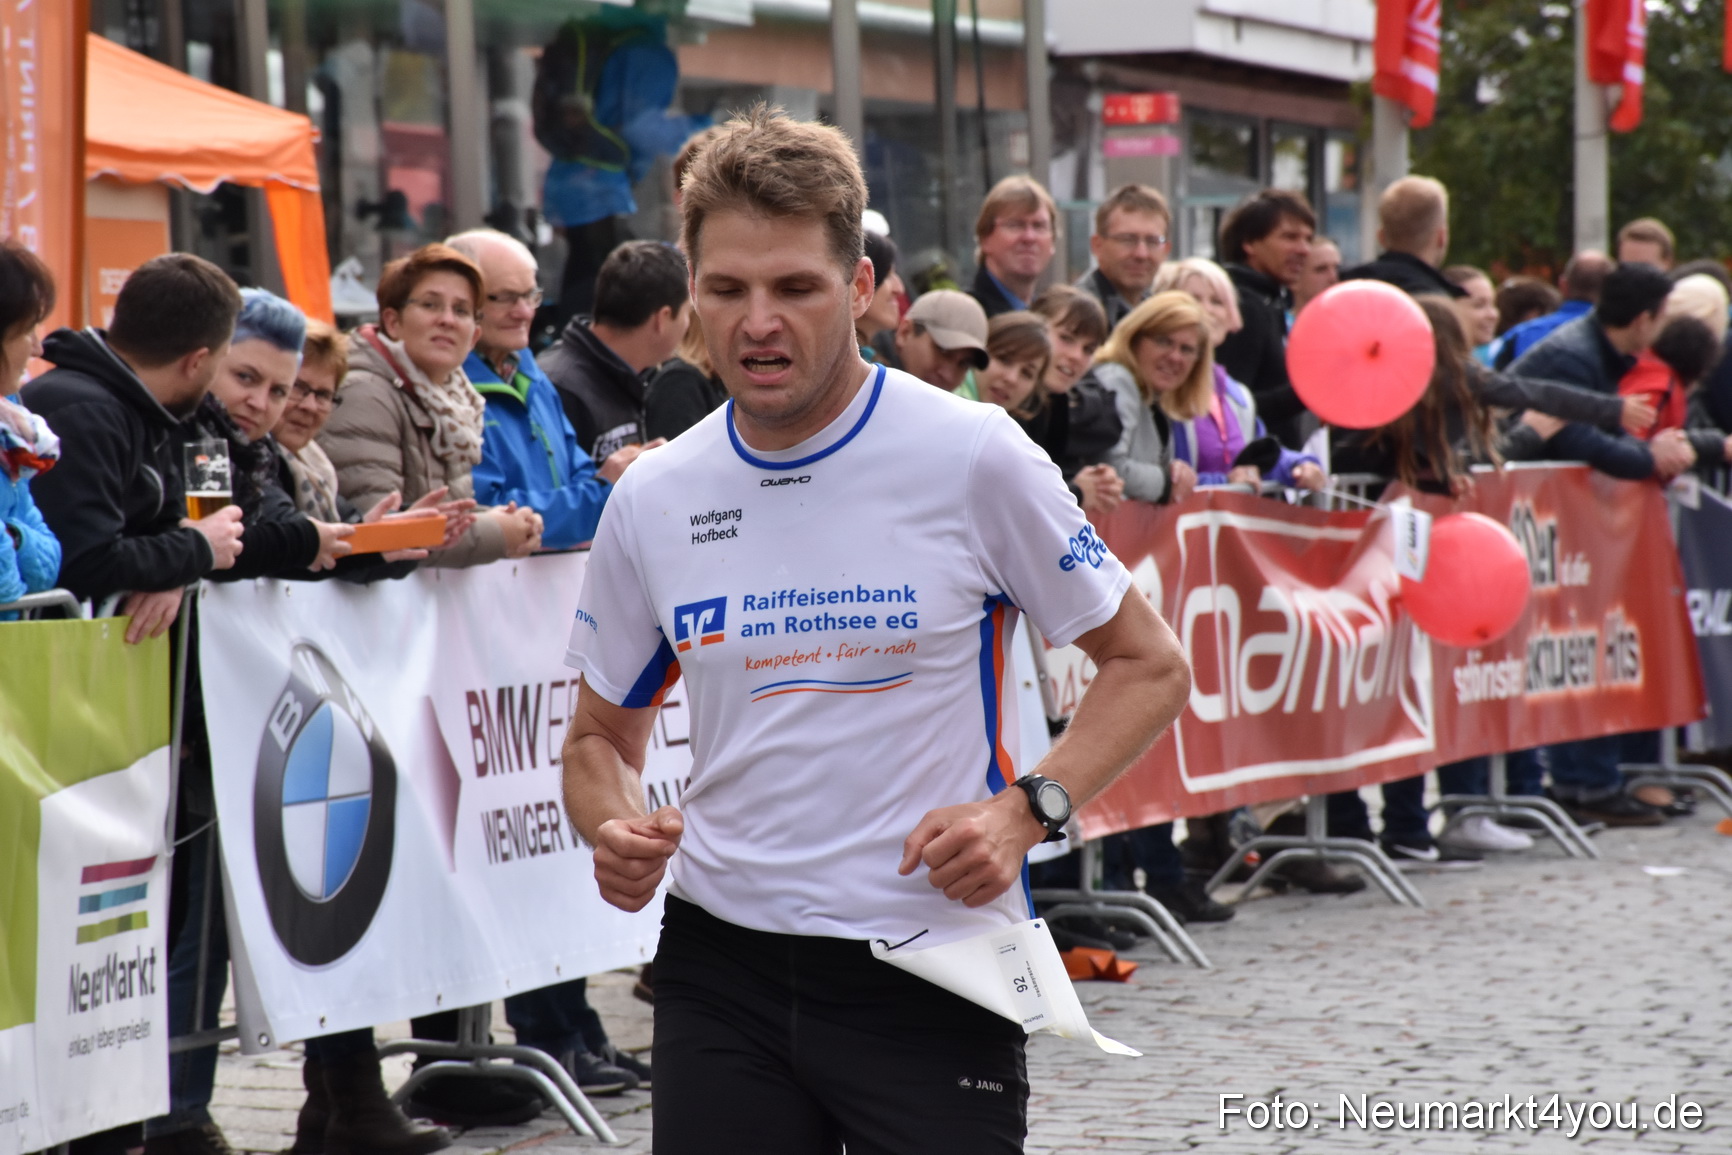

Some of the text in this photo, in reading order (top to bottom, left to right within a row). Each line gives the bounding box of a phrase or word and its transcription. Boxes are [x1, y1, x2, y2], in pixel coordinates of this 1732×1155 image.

[690, 508, 742, 526] Wolfgang
[691, 525, 738, 545] Hofbeck
[742, 584, 917, 612] Raiffeisenbank
[741, 611, 918, 638] am Rothsee eG
[745, 639, 916, 671] kompetent fair nah
[465, 683, 542, 778] BMW
[481, 801, 565, 865] WENIGER
[1013, 976, 1029, 993] 92
[976, 1079, 1003, 1093] JAKO
